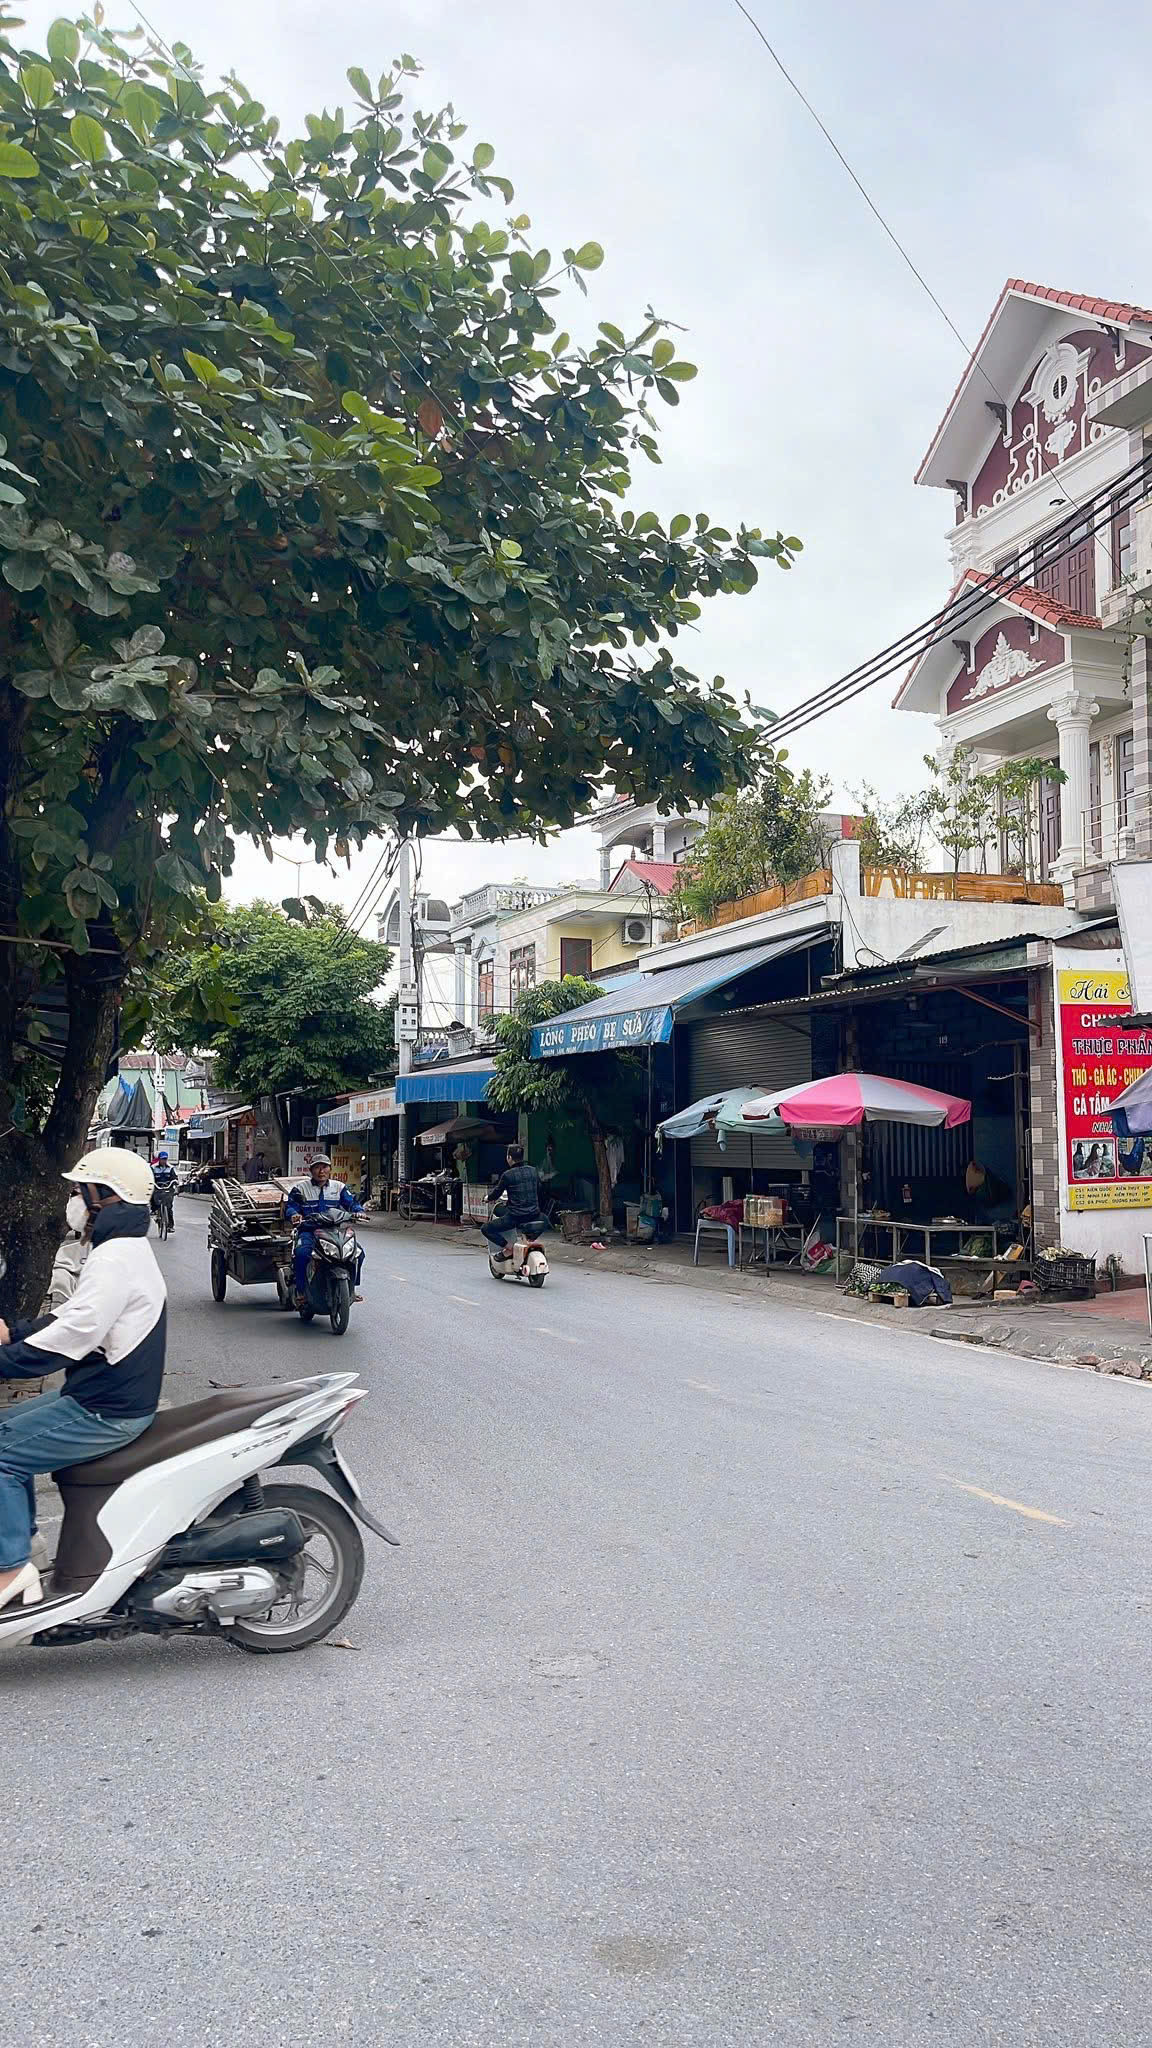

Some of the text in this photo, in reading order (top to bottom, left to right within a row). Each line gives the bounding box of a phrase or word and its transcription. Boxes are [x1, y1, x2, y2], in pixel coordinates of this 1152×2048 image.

[1070, 980, 1108, 1000] Hải
[1072, 1036, 1113, 1058] THỰC
[1072, 1063, 1087, 1086] THỎ
[1094, 1064, 1105, 1086] GÀ
[1106, 1064, 1117, 1086] ÁC
[1073, 1093, 1088, 1115] CÁ
